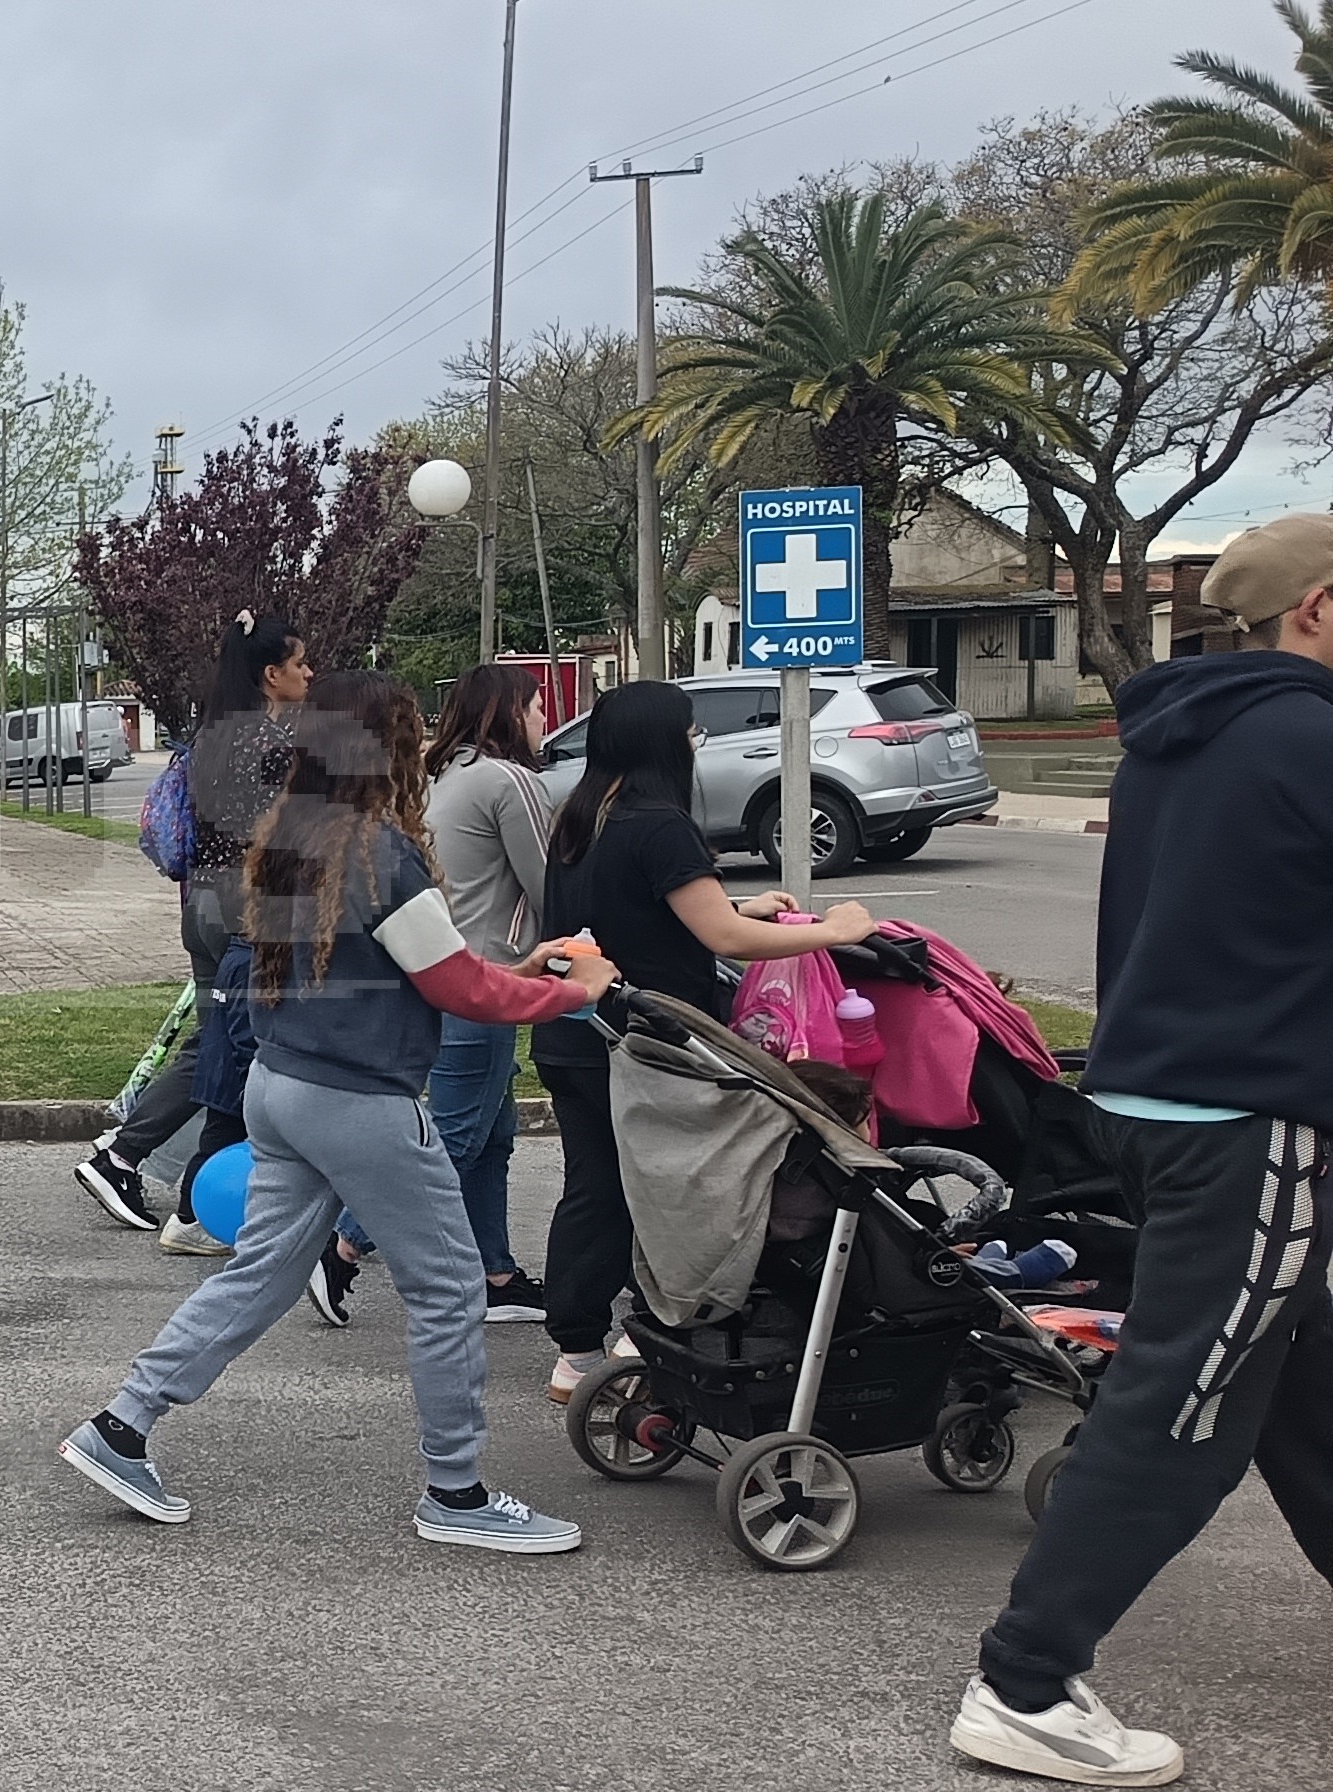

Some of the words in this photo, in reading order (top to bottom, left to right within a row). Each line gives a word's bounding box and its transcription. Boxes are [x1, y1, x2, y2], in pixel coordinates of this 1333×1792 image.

[746, 499, 854, 520] HOSPITAL
[783, 636, 833, 657] 400
[834, 637, 855, 646] MTS
